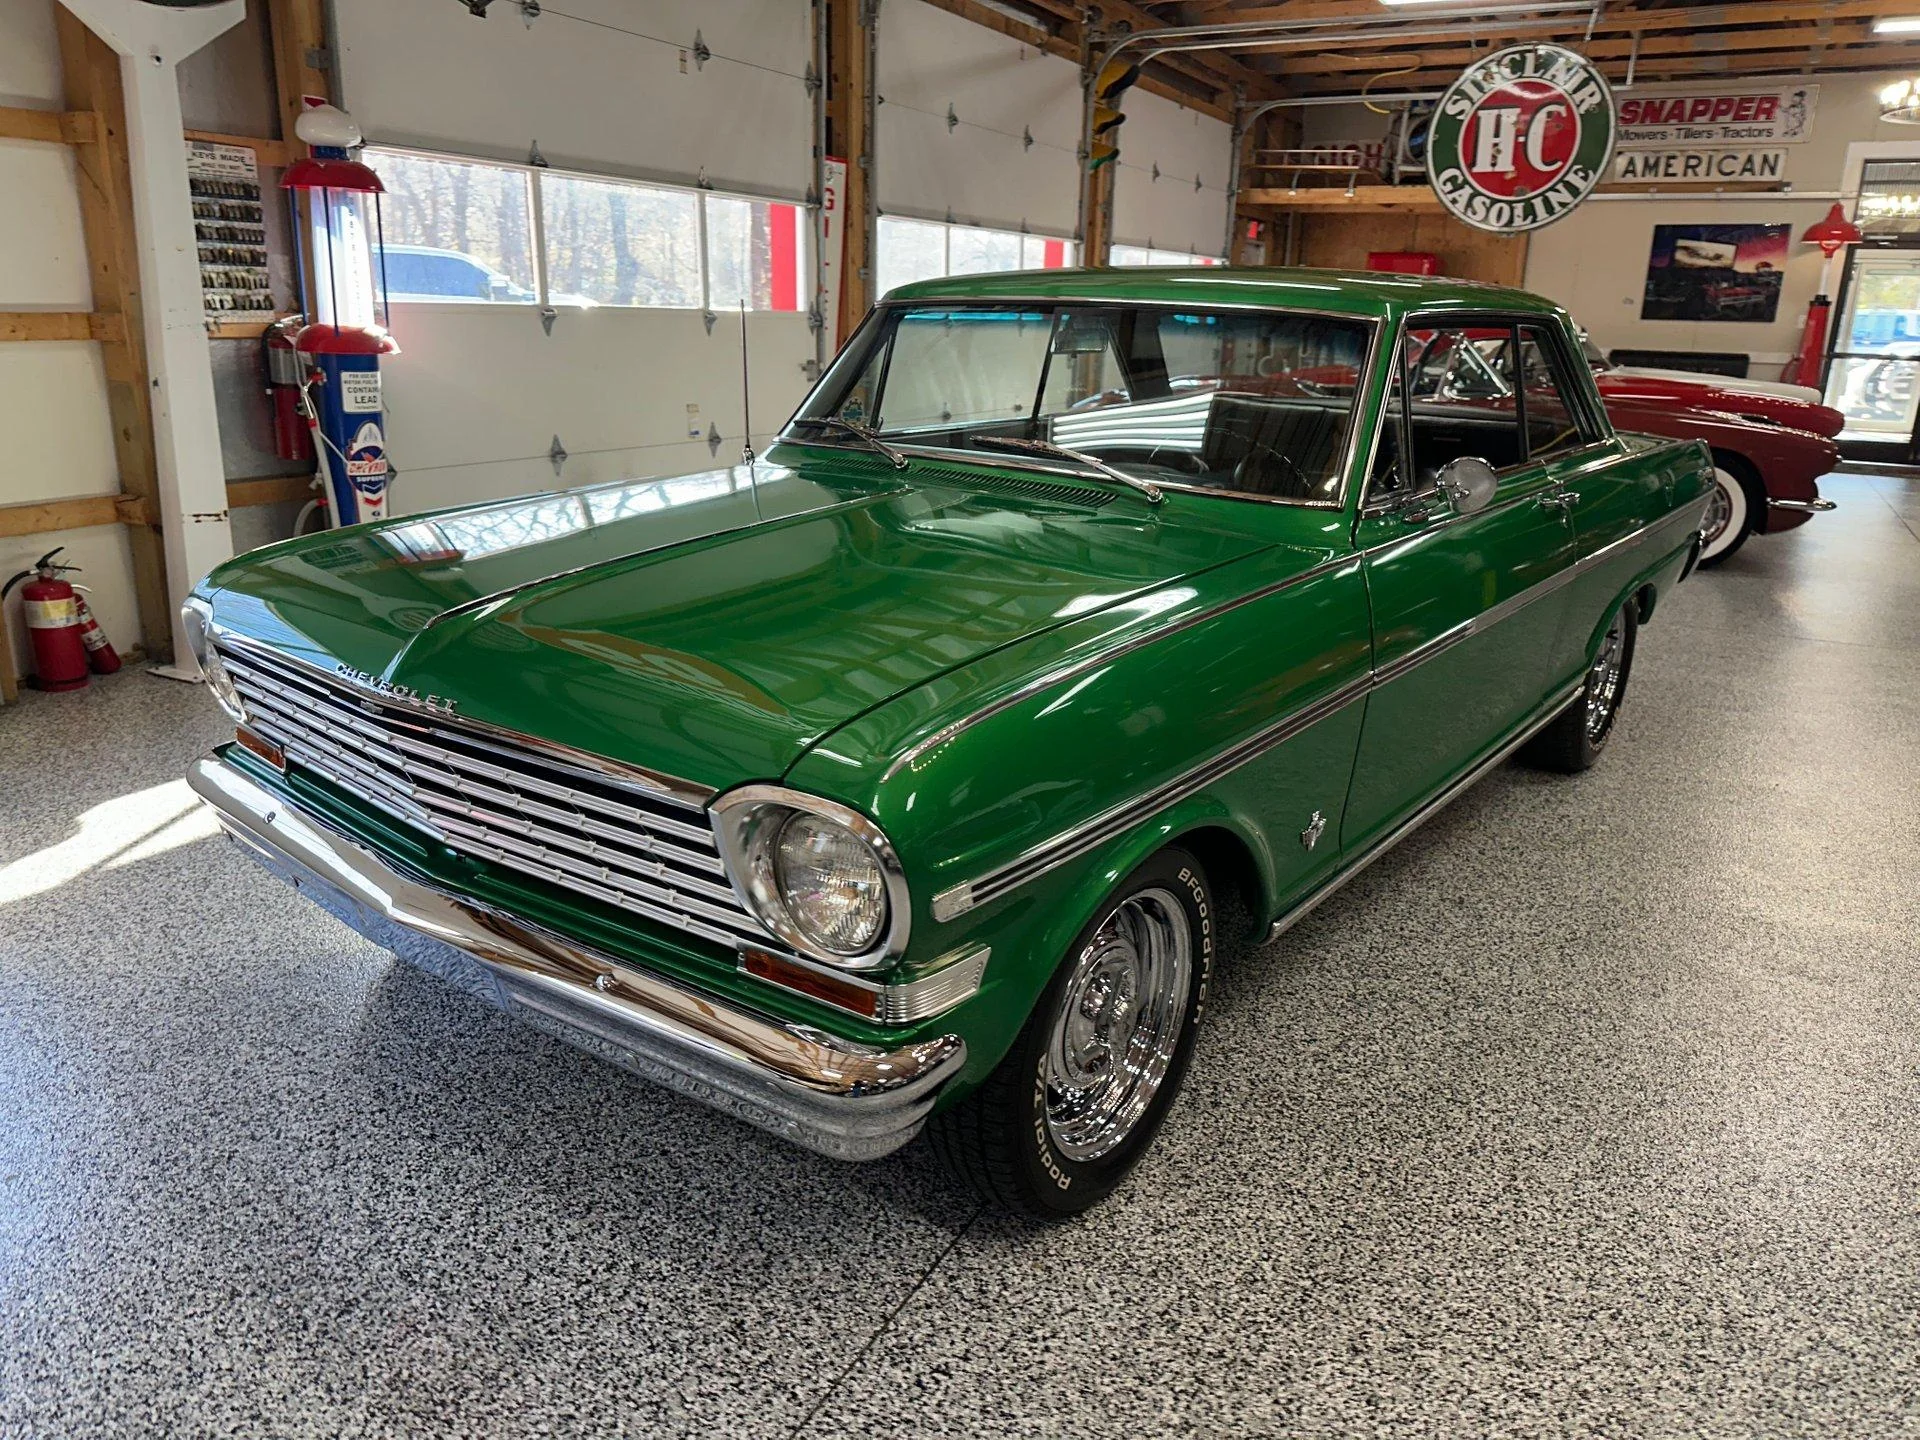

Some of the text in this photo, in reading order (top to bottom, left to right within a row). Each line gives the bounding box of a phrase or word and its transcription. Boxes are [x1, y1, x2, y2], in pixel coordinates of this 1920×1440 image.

[1445, 52, 1601, 120] SINCLAIR
[1618, 95, 1782, 126] SNAPPER
[1618, 125, 1774, 141] Mowers Tillers Tractors
[192, 152, 246, 163] KEYS MADE
[1621, 153, 1780, 179] AMERICAN
[1437, 167, 1595, 228] GASOLINE
[354, 395, 378, 404] LEAD
[335, 662, 458, 713] CHEVROLET
